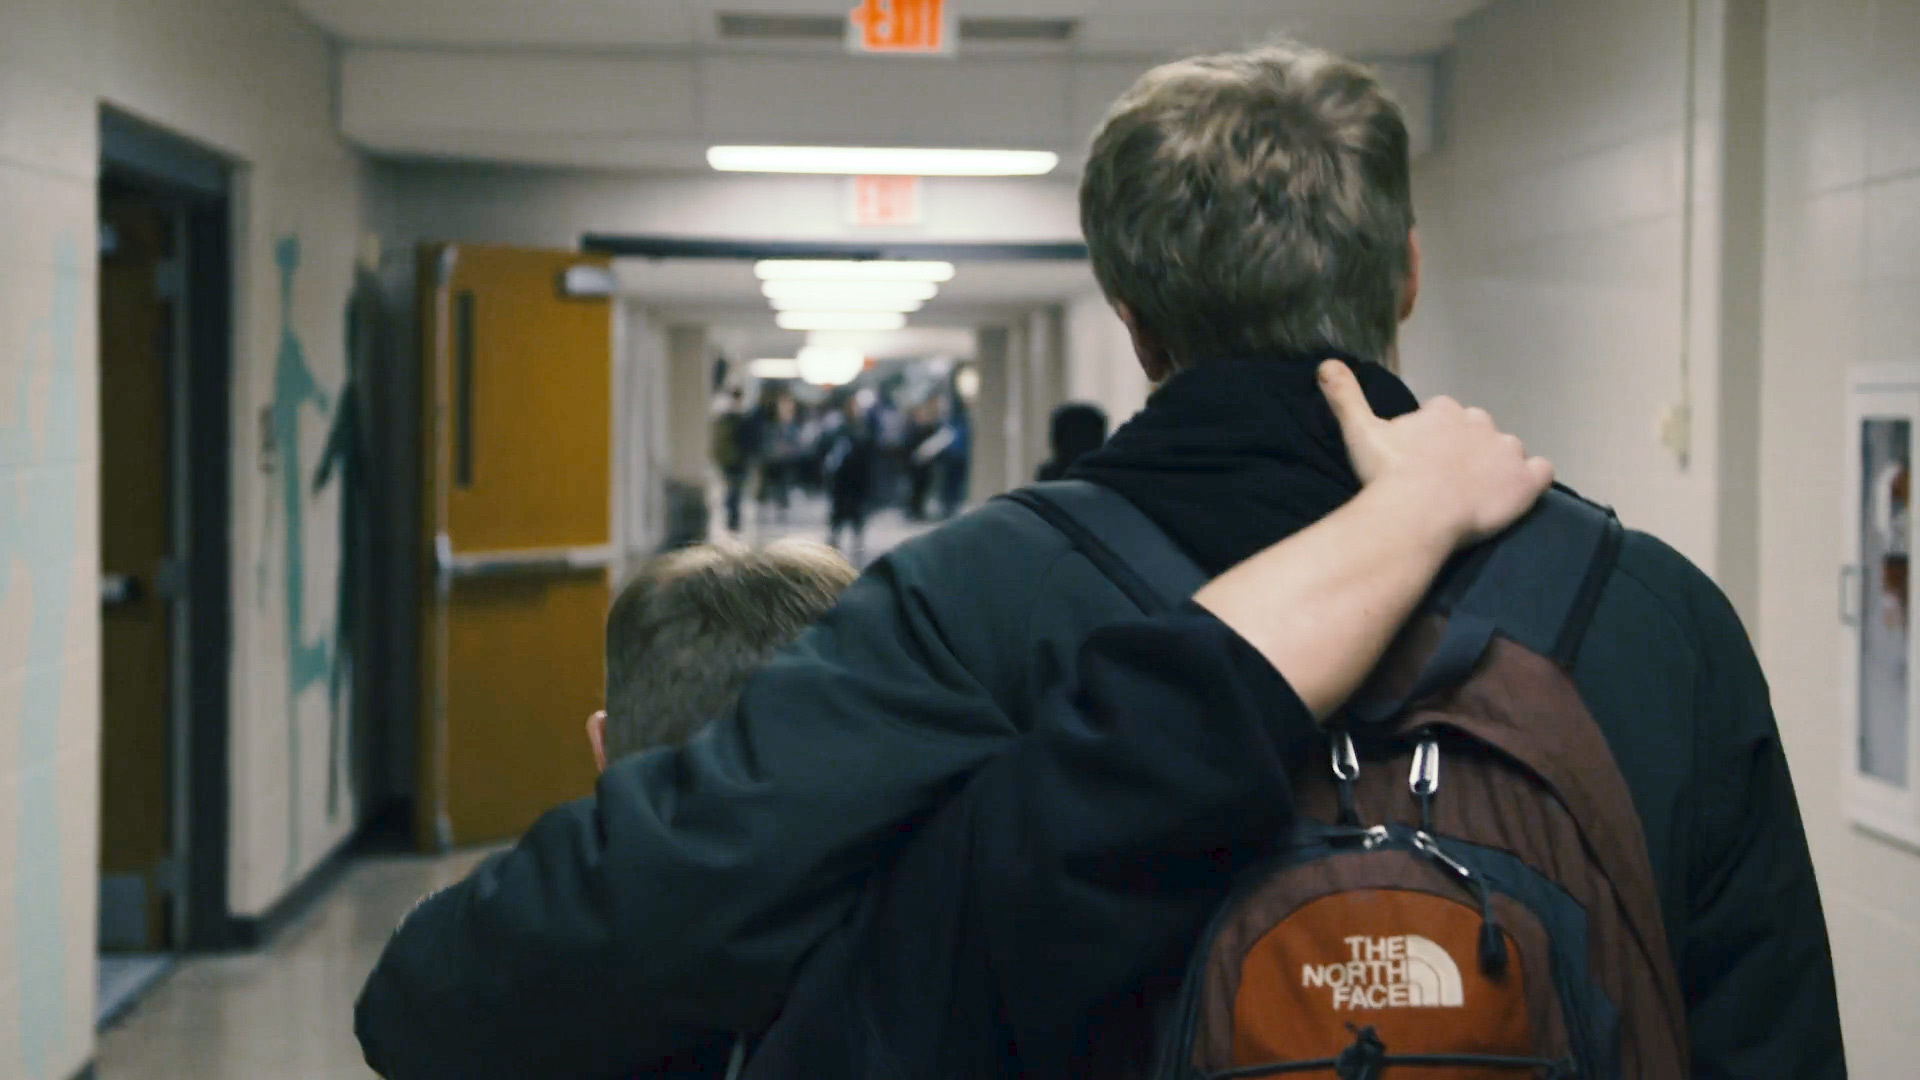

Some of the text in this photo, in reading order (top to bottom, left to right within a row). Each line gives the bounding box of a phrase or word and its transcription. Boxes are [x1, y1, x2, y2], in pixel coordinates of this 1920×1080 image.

[1344, 936, 1405, 961] THE
[1302, 961, 1408, 987] NORTH
[1333, 984, 1409, 1010] FACE
